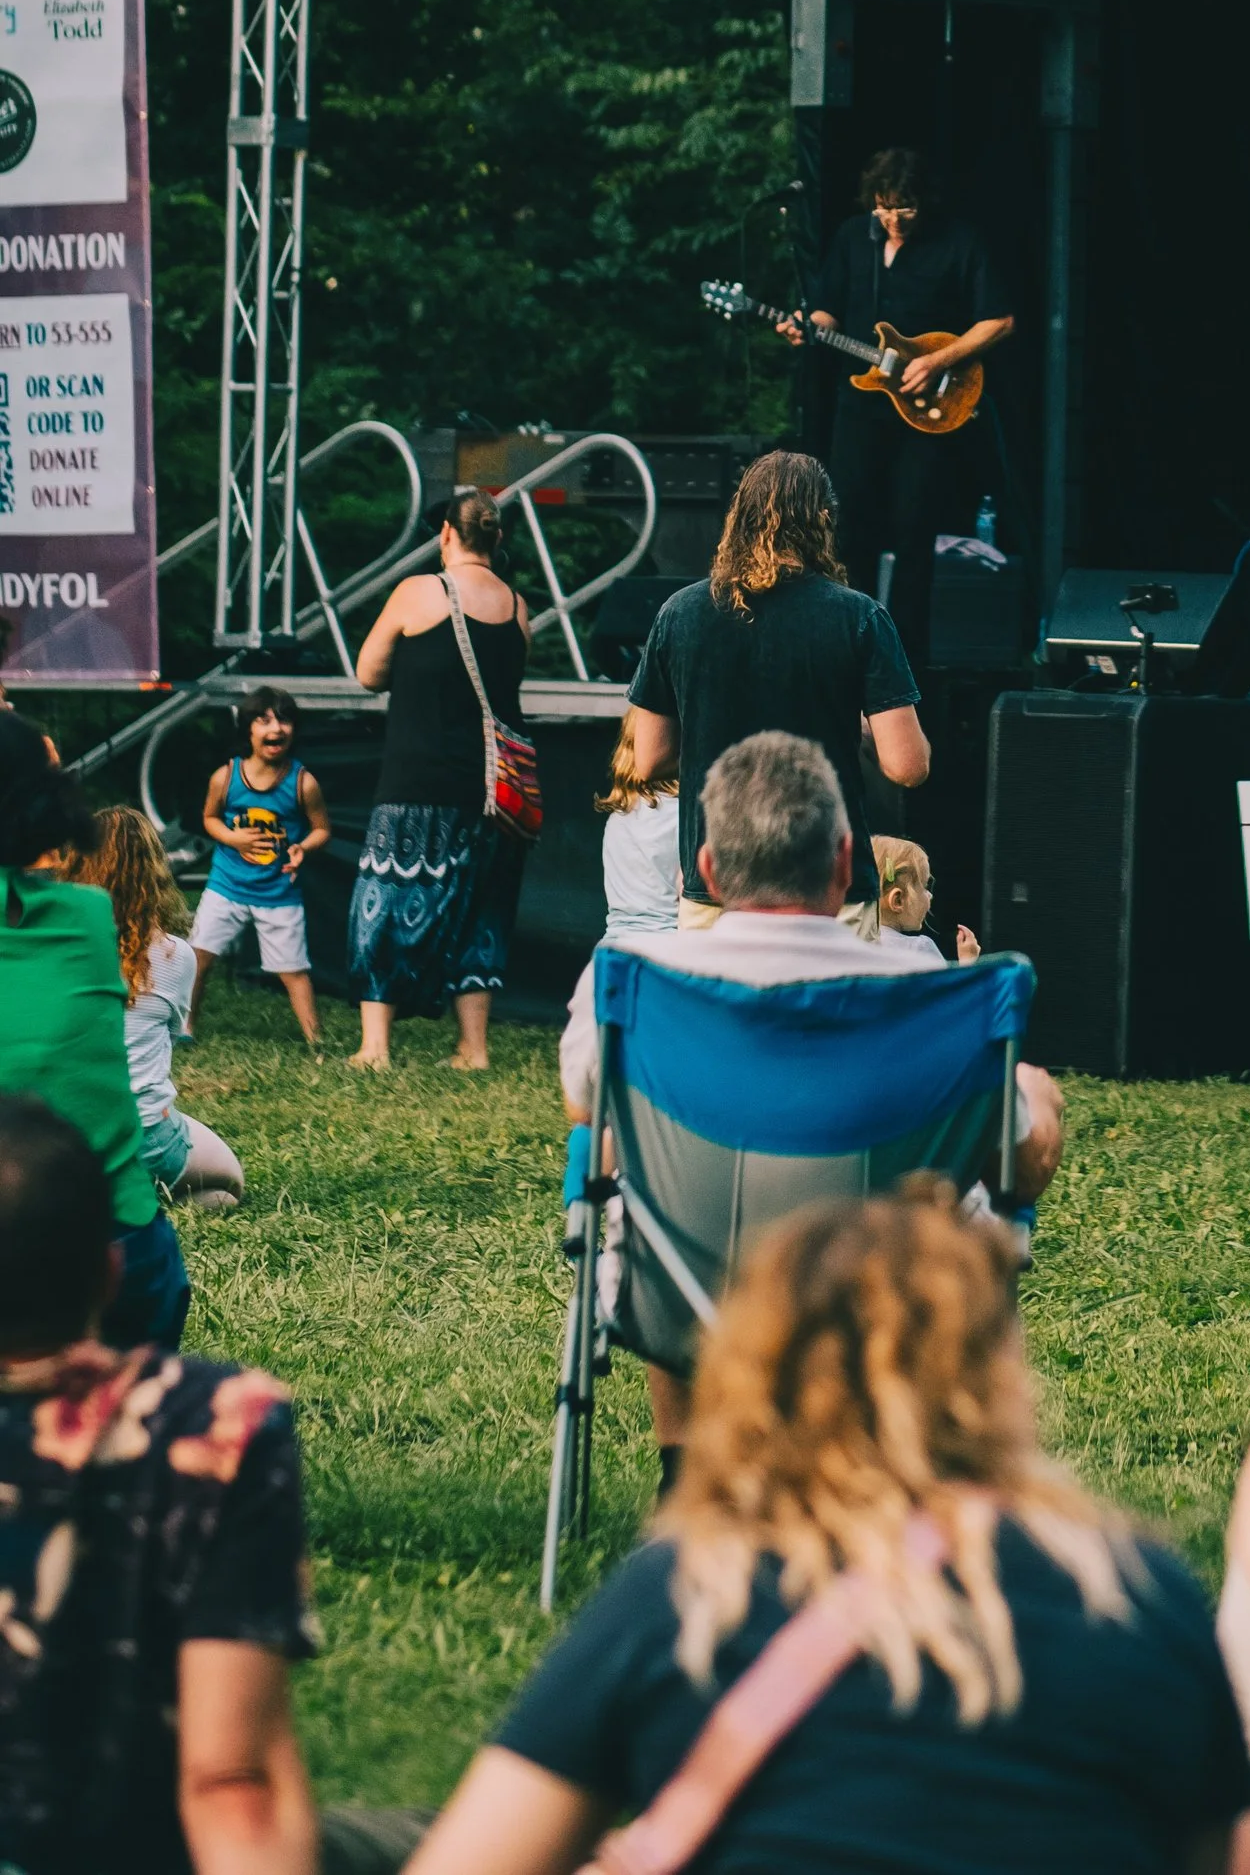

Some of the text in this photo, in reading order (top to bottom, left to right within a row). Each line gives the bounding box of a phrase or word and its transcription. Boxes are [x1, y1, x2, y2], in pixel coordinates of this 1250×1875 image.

[47, 17, 102, 40] Todd
[25, 322, 46, 346] TO
[51, 320, 112, 344] 53-555
[26, 373, 105, 398] OR SCAN
[27, 410, 104, 435] CODE TO
[29, 447, 99, 472] DONATE
[32, 484, 92, 508] ONLINE
